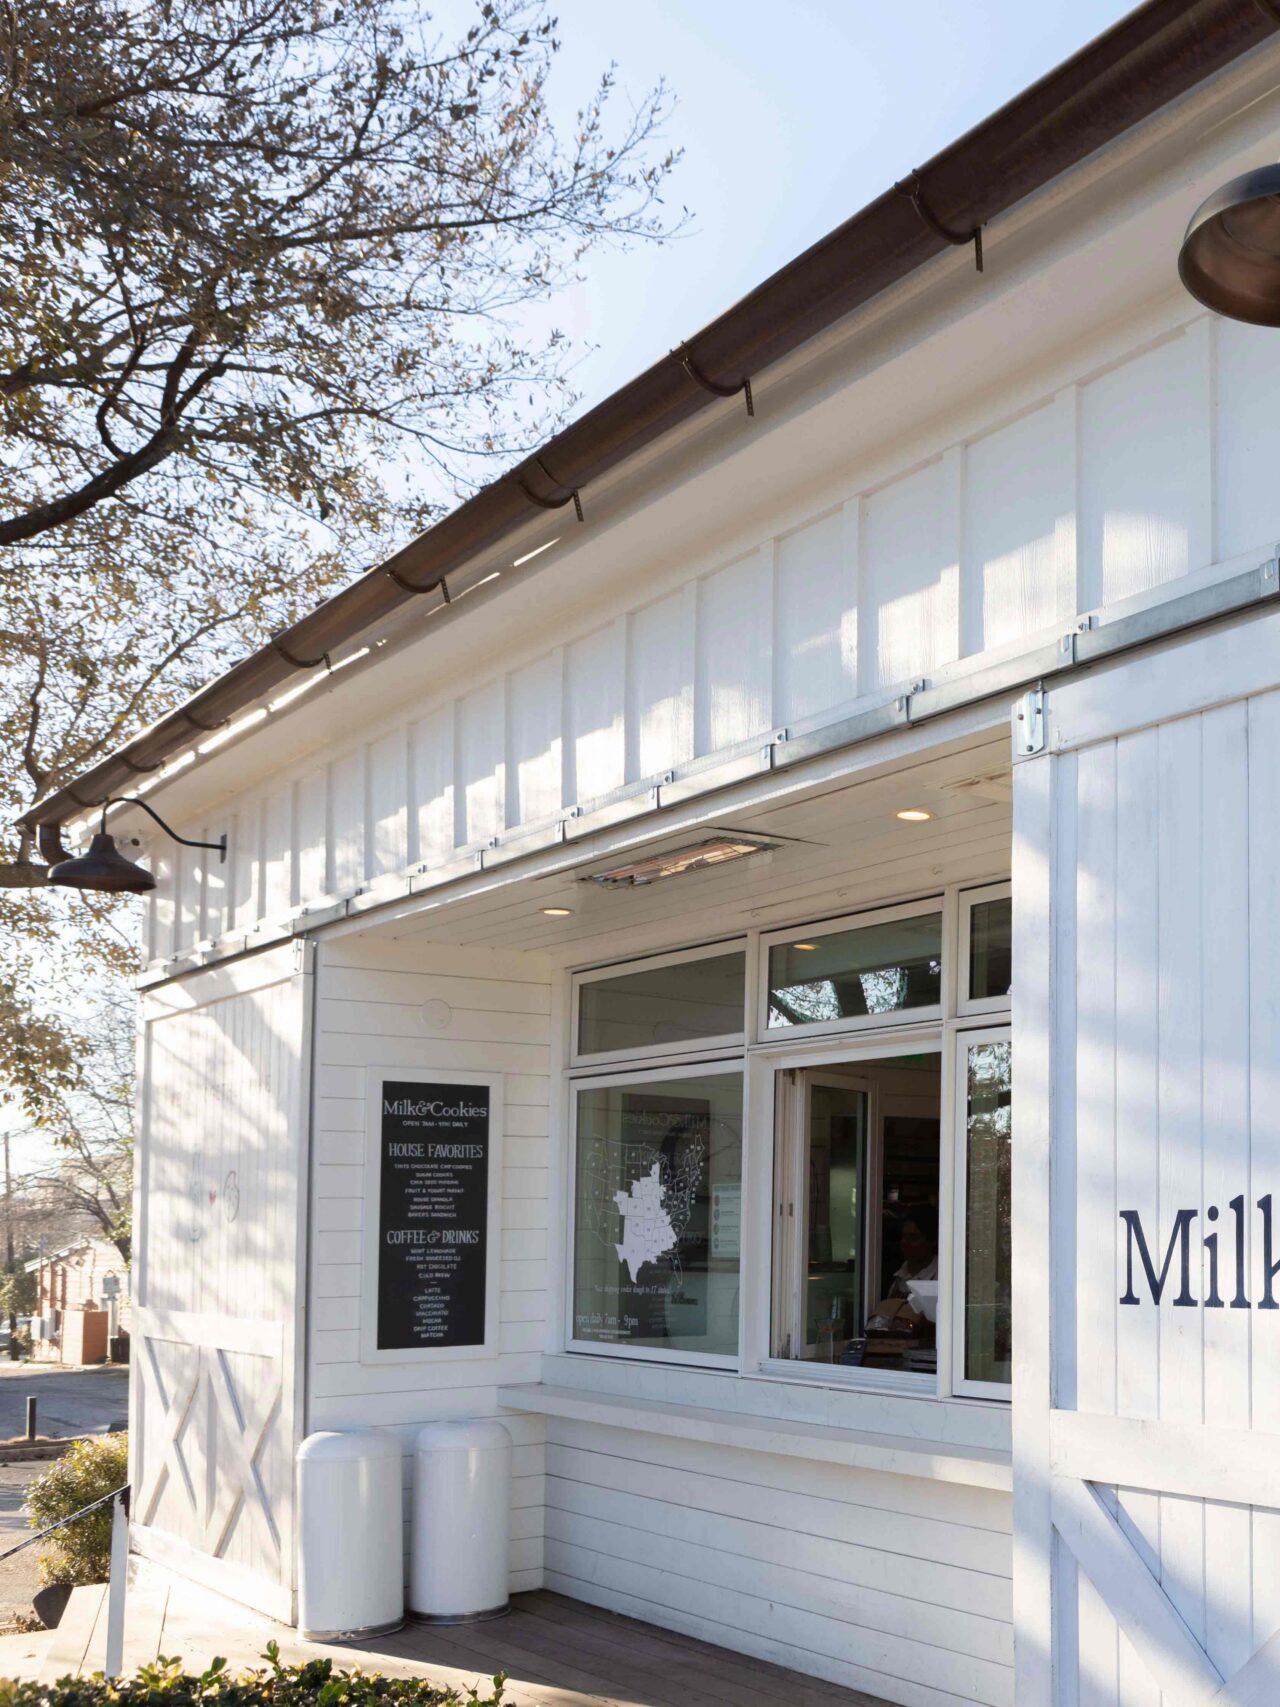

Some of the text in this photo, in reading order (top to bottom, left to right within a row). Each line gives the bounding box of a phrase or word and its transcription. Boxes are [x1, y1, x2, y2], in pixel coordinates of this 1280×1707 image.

[388, 1143, 483, 1158] HOUSE FAVORITES
[386, 1230, 479, 1244] COFFEE & DRINKS
[624, 1314, 639, 1329] 9pm
